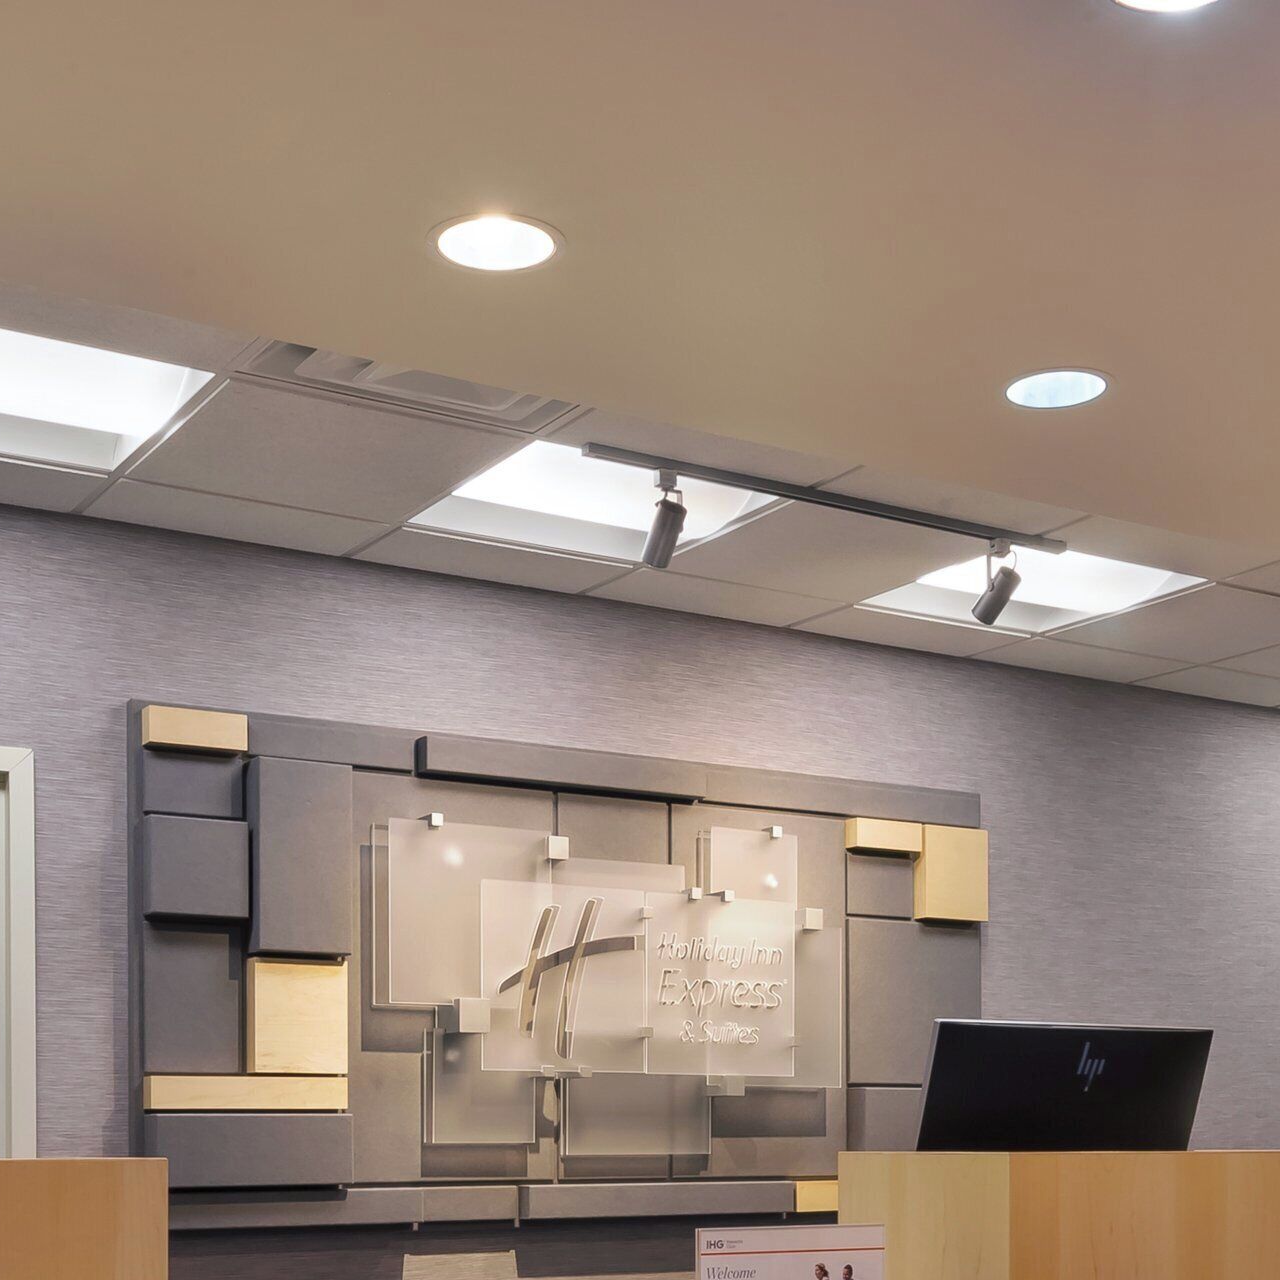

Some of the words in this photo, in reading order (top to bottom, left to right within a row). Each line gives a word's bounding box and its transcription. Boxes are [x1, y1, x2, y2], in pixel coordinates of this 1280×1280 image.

[657, 932, 745, 969] Holiday
[748, 938, 783, 965] Inn
[658, 967, 784, 1017] Express
[680, 1020, 695, 1043] &
[699, 1020, 760, 1045] Suites
[706, 1239, 725, 1250] IHG
[706, 1266, 757, 1280] Welcome
